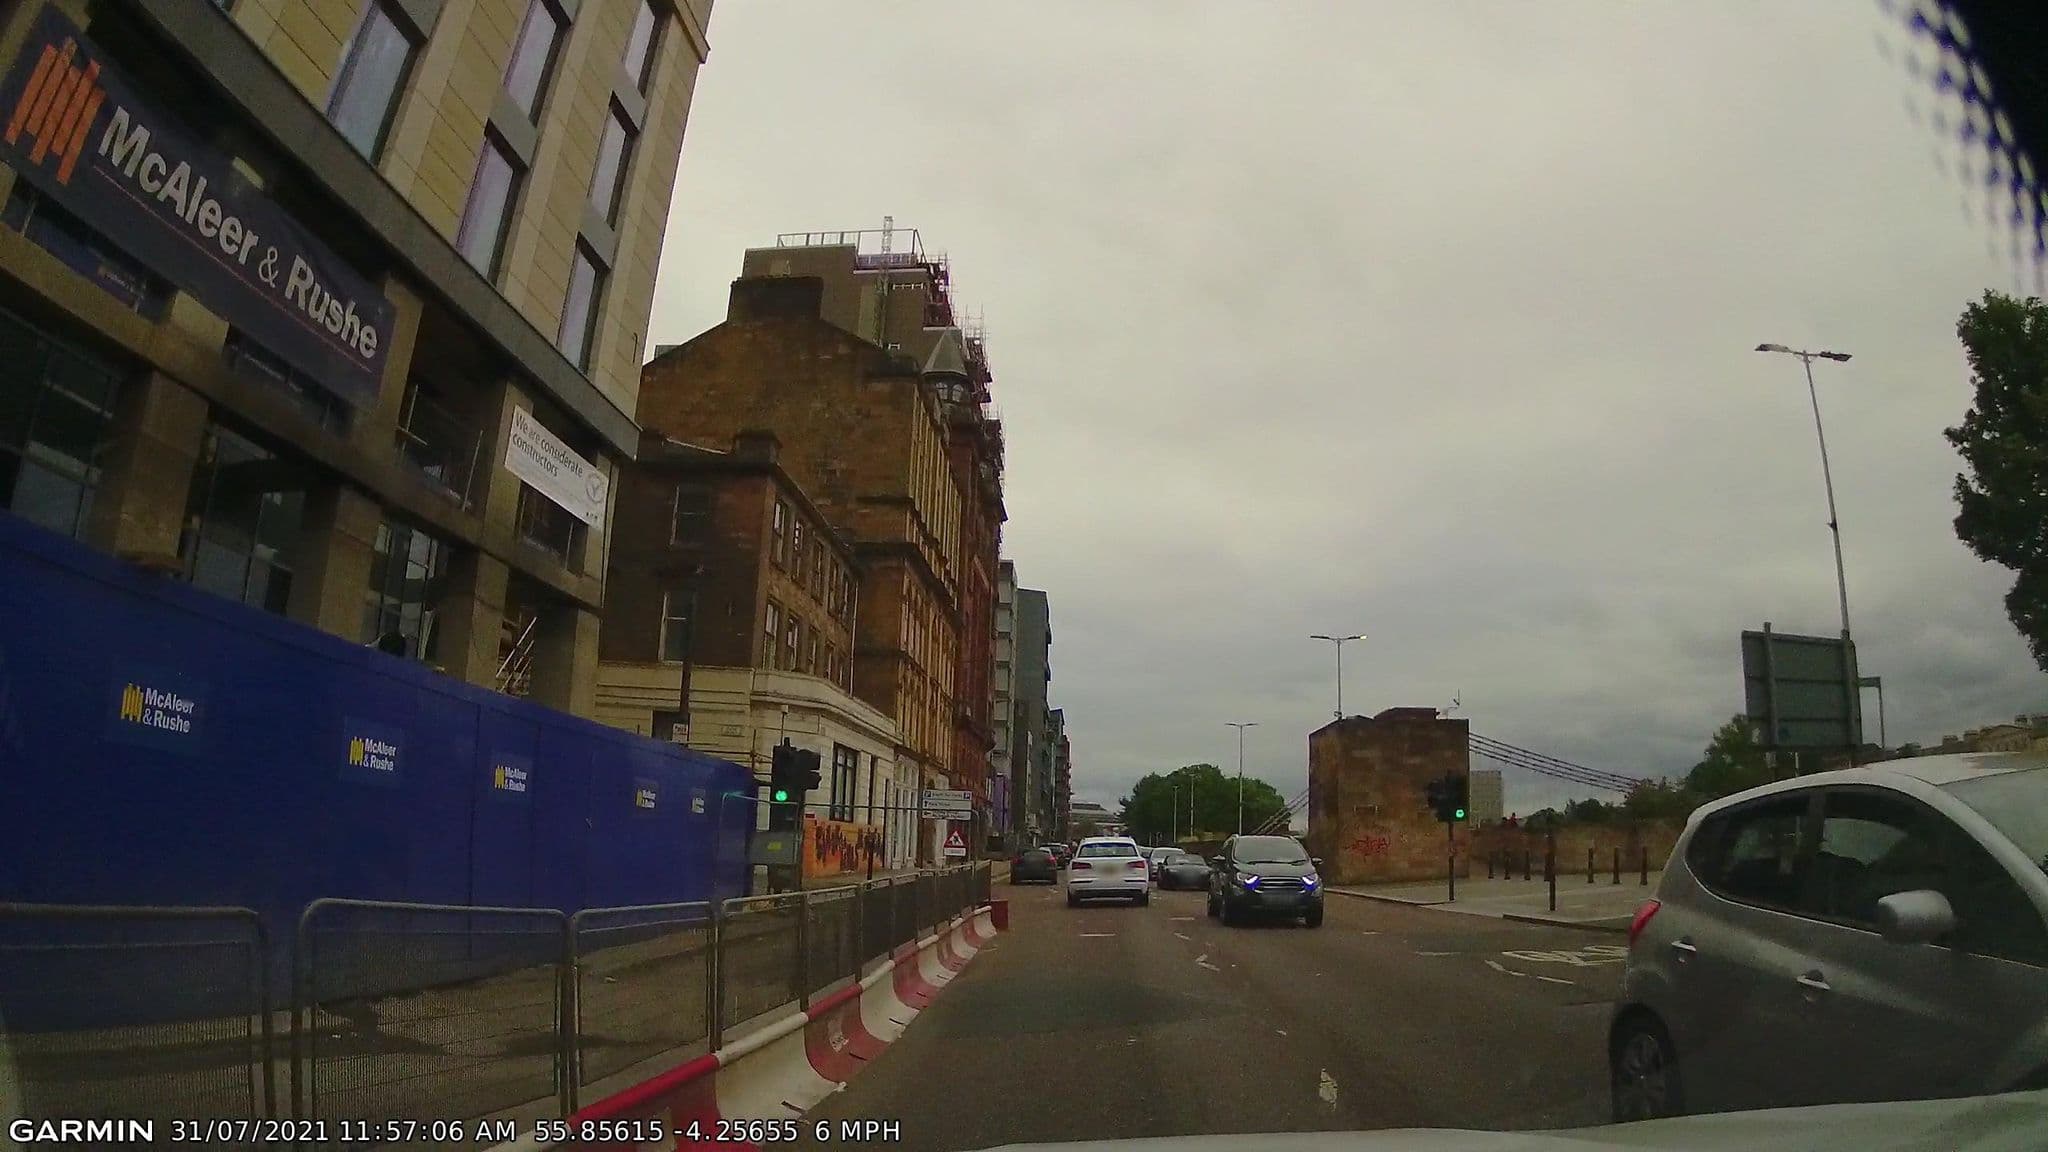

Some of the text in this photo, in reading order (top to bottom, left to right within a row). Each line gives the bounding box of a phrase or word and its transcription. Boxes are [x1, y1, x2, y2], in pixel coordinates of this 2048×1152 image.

[98, 105, 378, 359] McAleer & Rushe
[512, 433, 558, 477] constructors
[516, 414, 529, 433] We
[540, 438, 583, 478] considerate
[145, 687, 195, 714] McAleer
[142, 708, 192, 733] & Rushe
[364, 737, 397, 757] McAleer
[369, 754, 395, 772] Rushe
